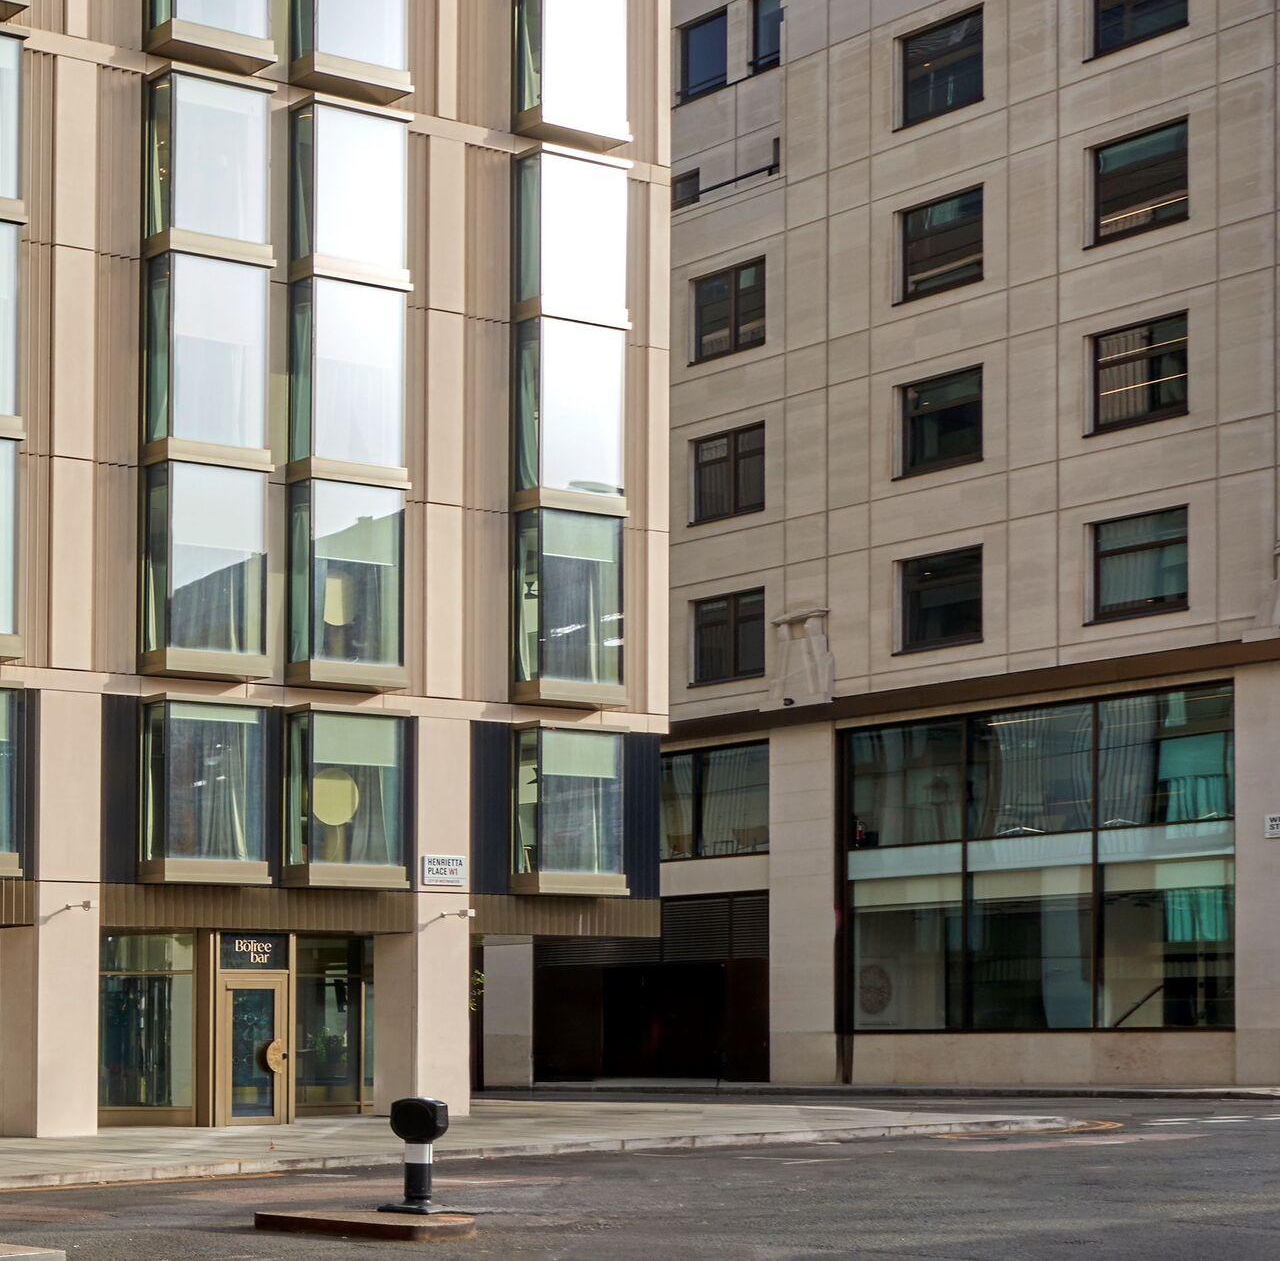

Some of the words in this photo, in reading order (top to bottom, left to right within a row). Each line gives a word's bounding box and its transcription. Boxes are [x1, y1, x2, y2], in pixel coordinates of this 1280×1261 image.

[427, 858, 463, 867] HENRIETTA
[427, 867, 447, 876] PLACE
[448, 868, 458, 876] W1
[250, 951, 270, 964] bar
